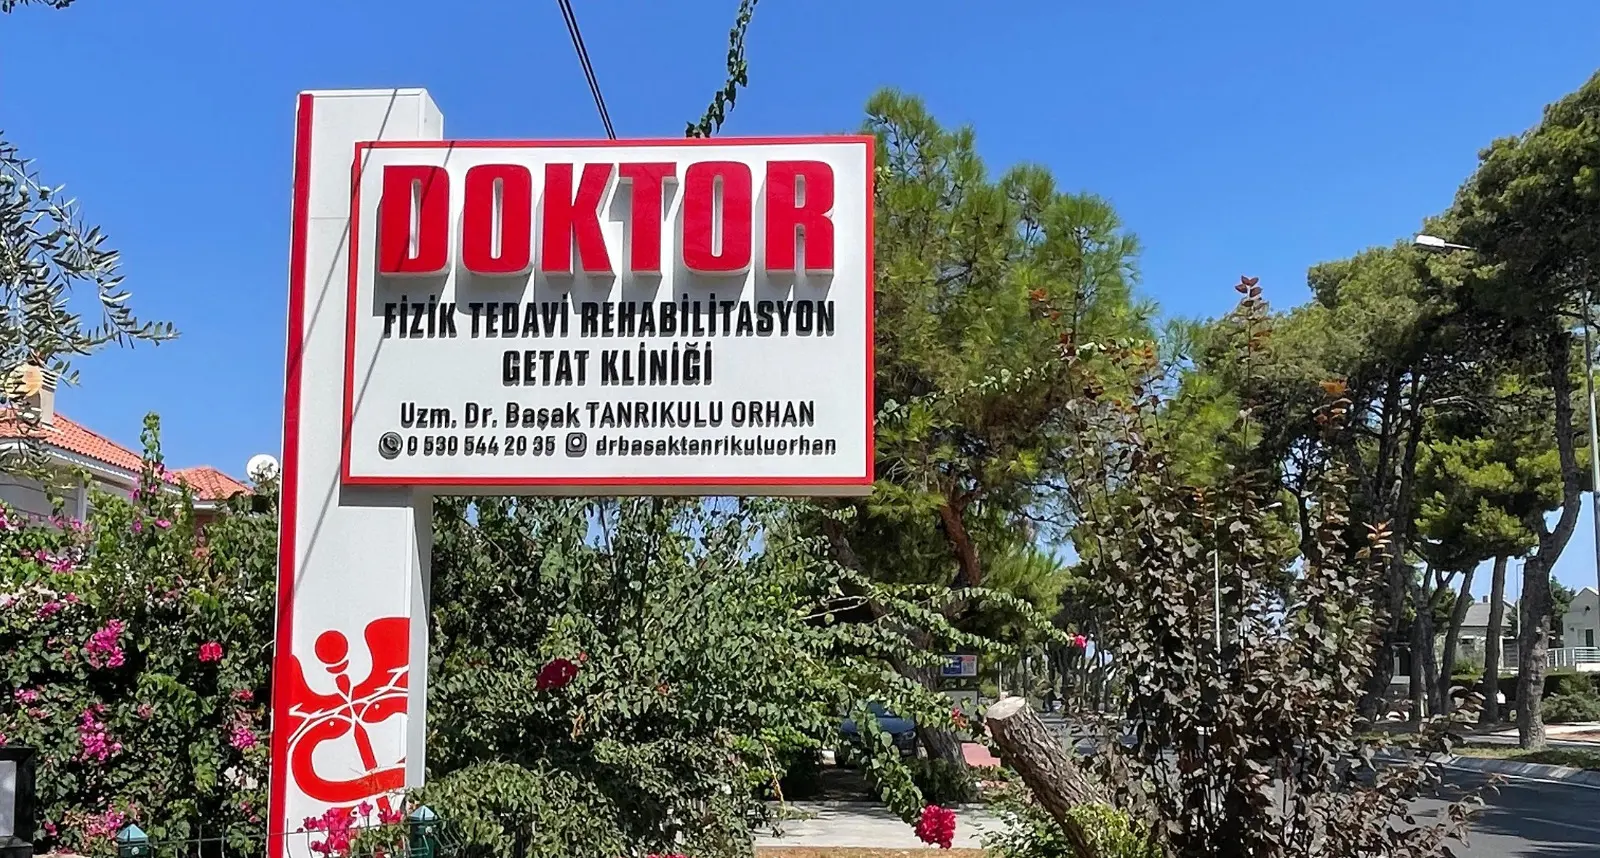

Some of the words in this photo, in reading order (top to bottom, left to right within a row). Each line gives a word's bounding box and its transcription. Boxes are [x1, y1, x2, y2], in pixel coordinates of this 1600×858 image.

[380, 161, 834, 276] DOKTOR
[383, 295, 456, 339] FİZİK
[469, 294, 569, 338] TEDAVİ
[581, 293, 835, 337] REHABİLİTASYON
[502, 349, 590, 386] GETAT
[601, 341, 713, 386] KLİNİĞİ
[400, 401, 457, 428] Uzm.
[464, 402, 497, 428] Dr.
[506, 402, 580, 430] Başak
[585, 401, 723, 428] TANRIKULU
[731, 401, 814, 427] ORHAN
[407, 436, 417, 456] 0
[423, 436, 458, 456] 530
[464, 436, 499, 456] 544
[505, 436, 527, 456] 20
[532, 436, 555, 456] 35
[596, 435, 836, 456] drbasaktanrikuluorhan
